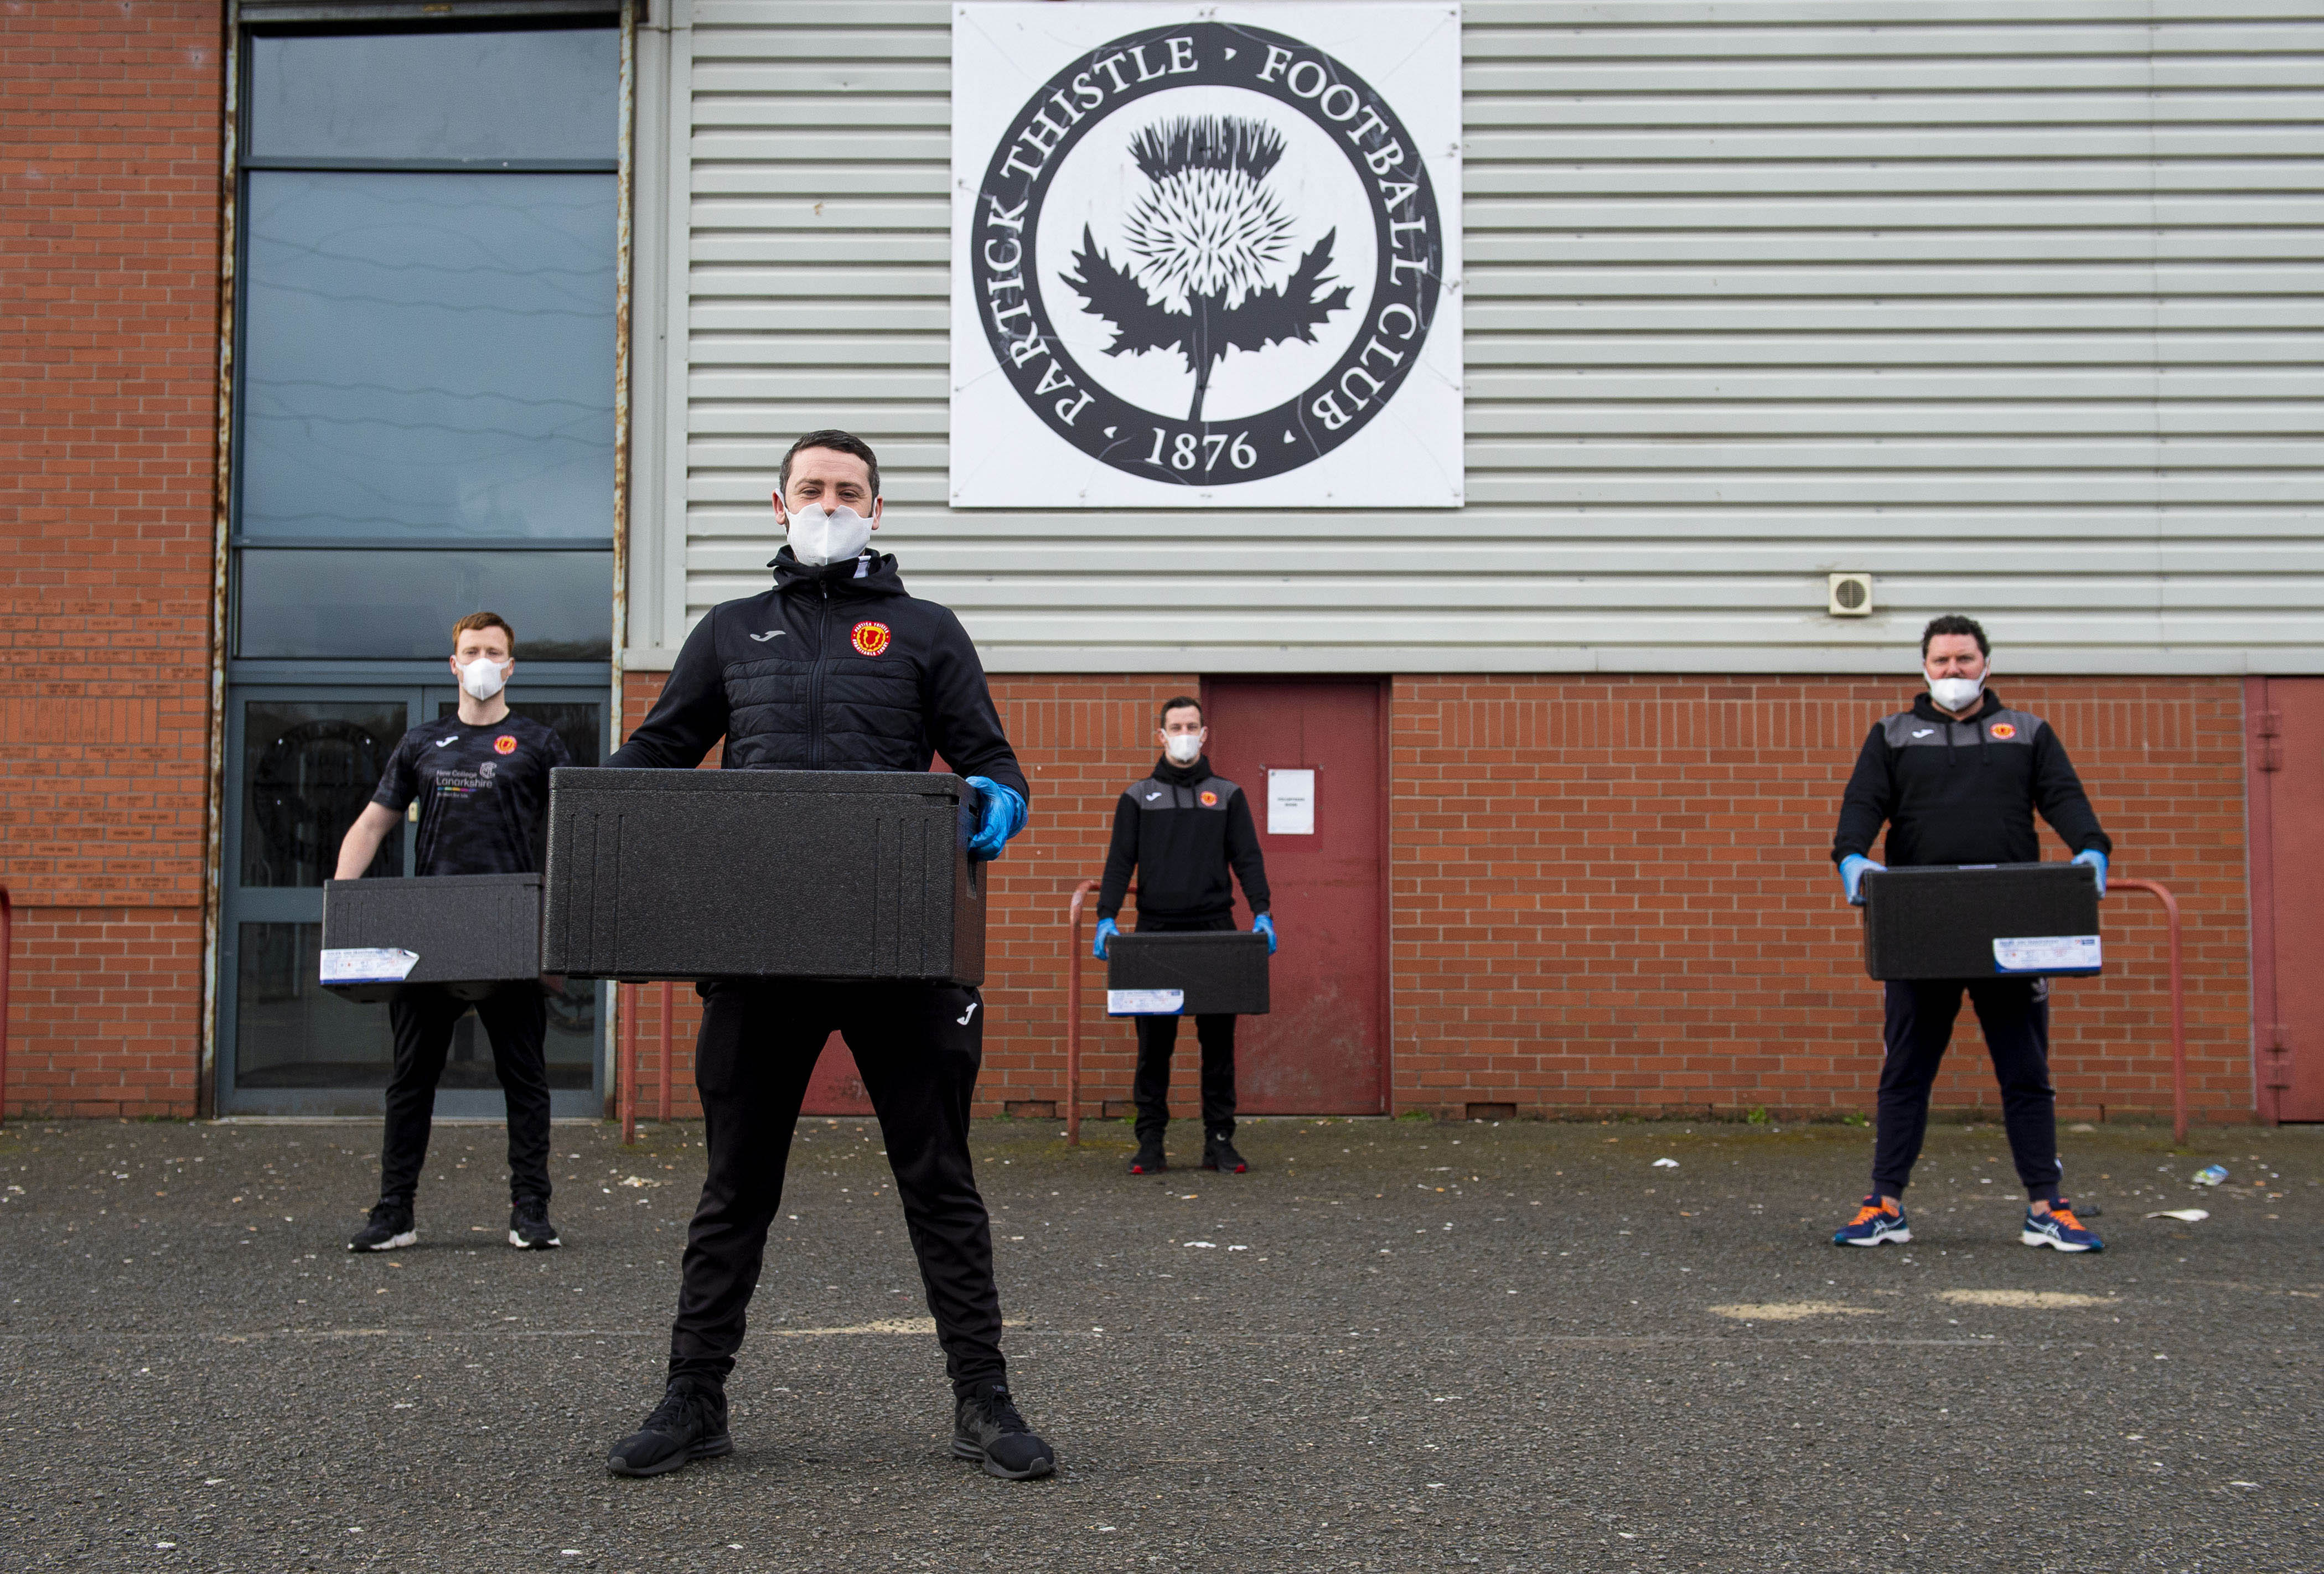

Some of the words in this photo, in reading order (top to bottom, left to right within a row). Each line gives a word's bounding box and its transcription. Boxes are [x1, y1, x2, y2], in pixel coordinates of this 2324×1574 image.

[1000, 37, 1198, 182] THISTLE
[1256, 44, 1428, 286] FOOTBALL
[985, 195, 1095, 427] PARTICK
[1311, 303, 1416, 430] CLUB
[1145, 427, 1257, 472] 1876
[436, 776, 493, 788] Lanarkshire
[452, 769, 477, 779] College
